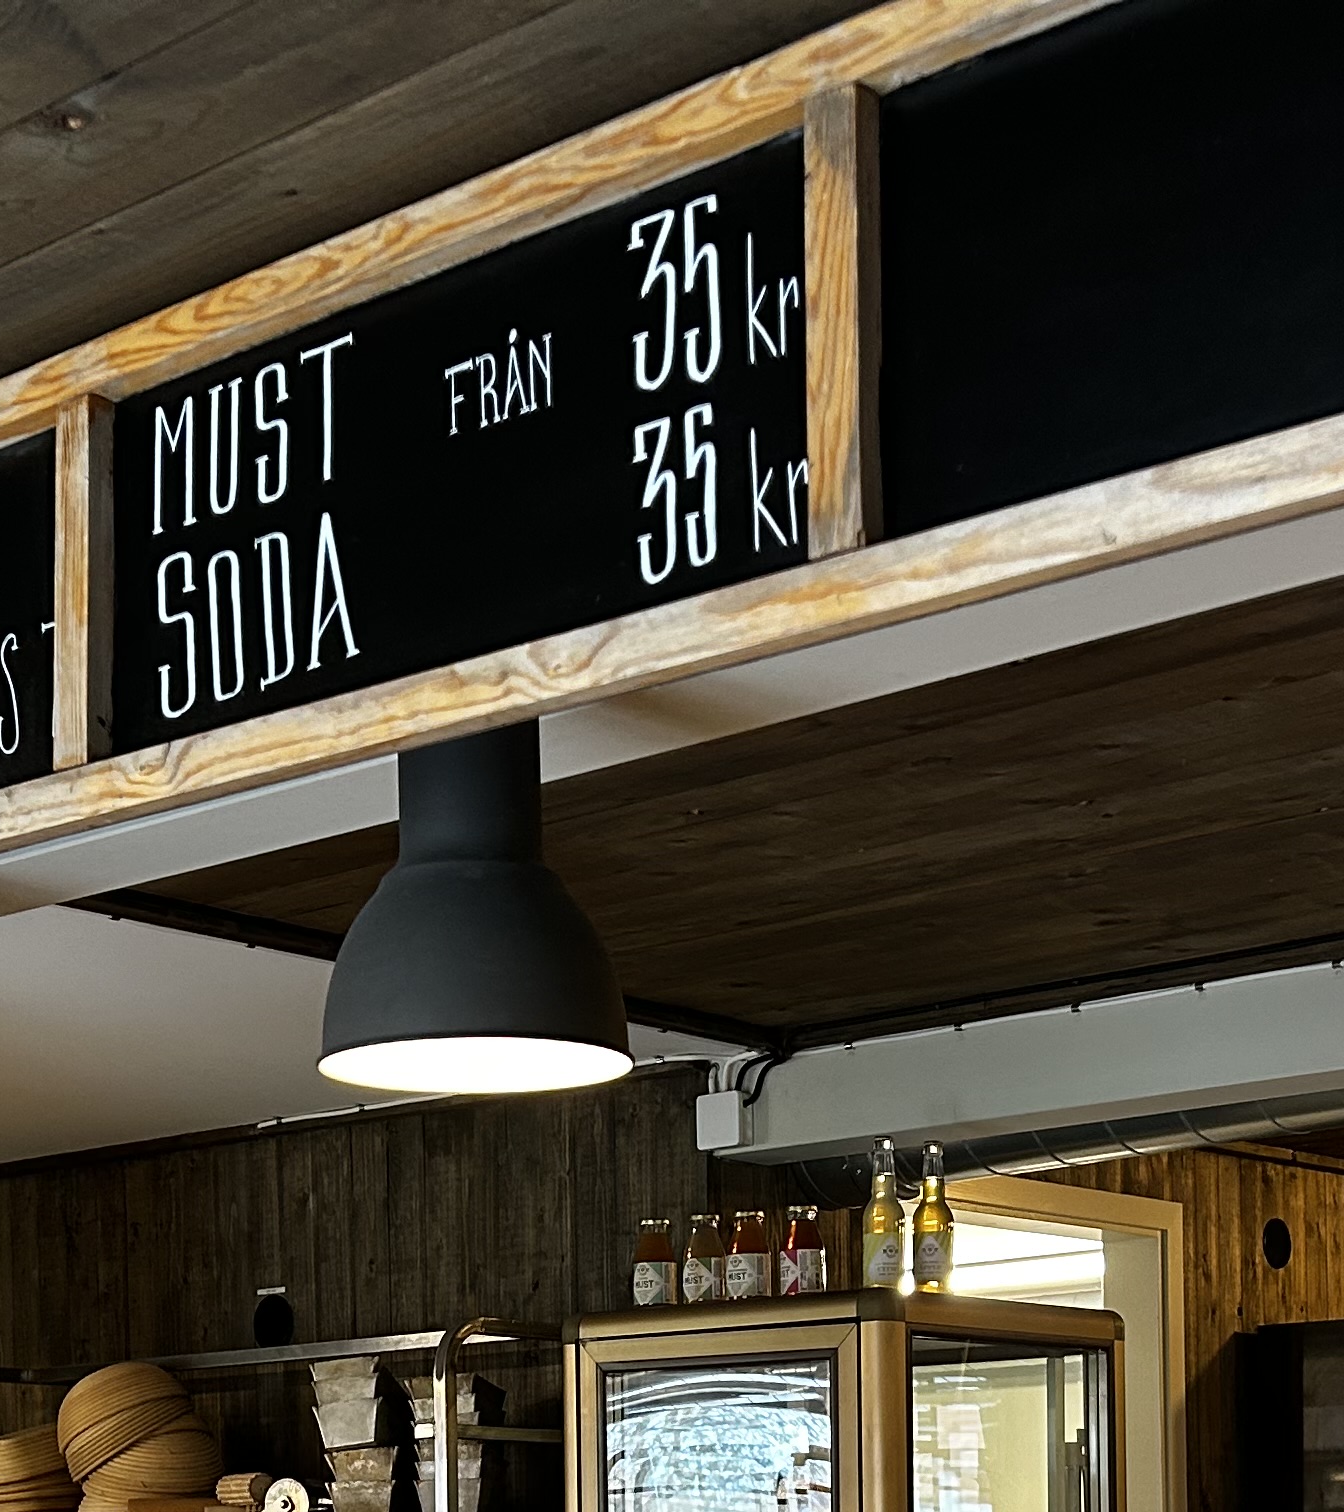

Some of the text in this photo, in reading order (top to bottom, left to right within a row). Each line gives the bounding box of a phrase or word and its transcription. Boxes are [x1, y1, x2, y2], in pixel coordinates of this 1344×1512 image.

[151, 194, 800, 537] MUST FRÅN 35 kr
[157, 402, 809, 721] SODA 35 kr
